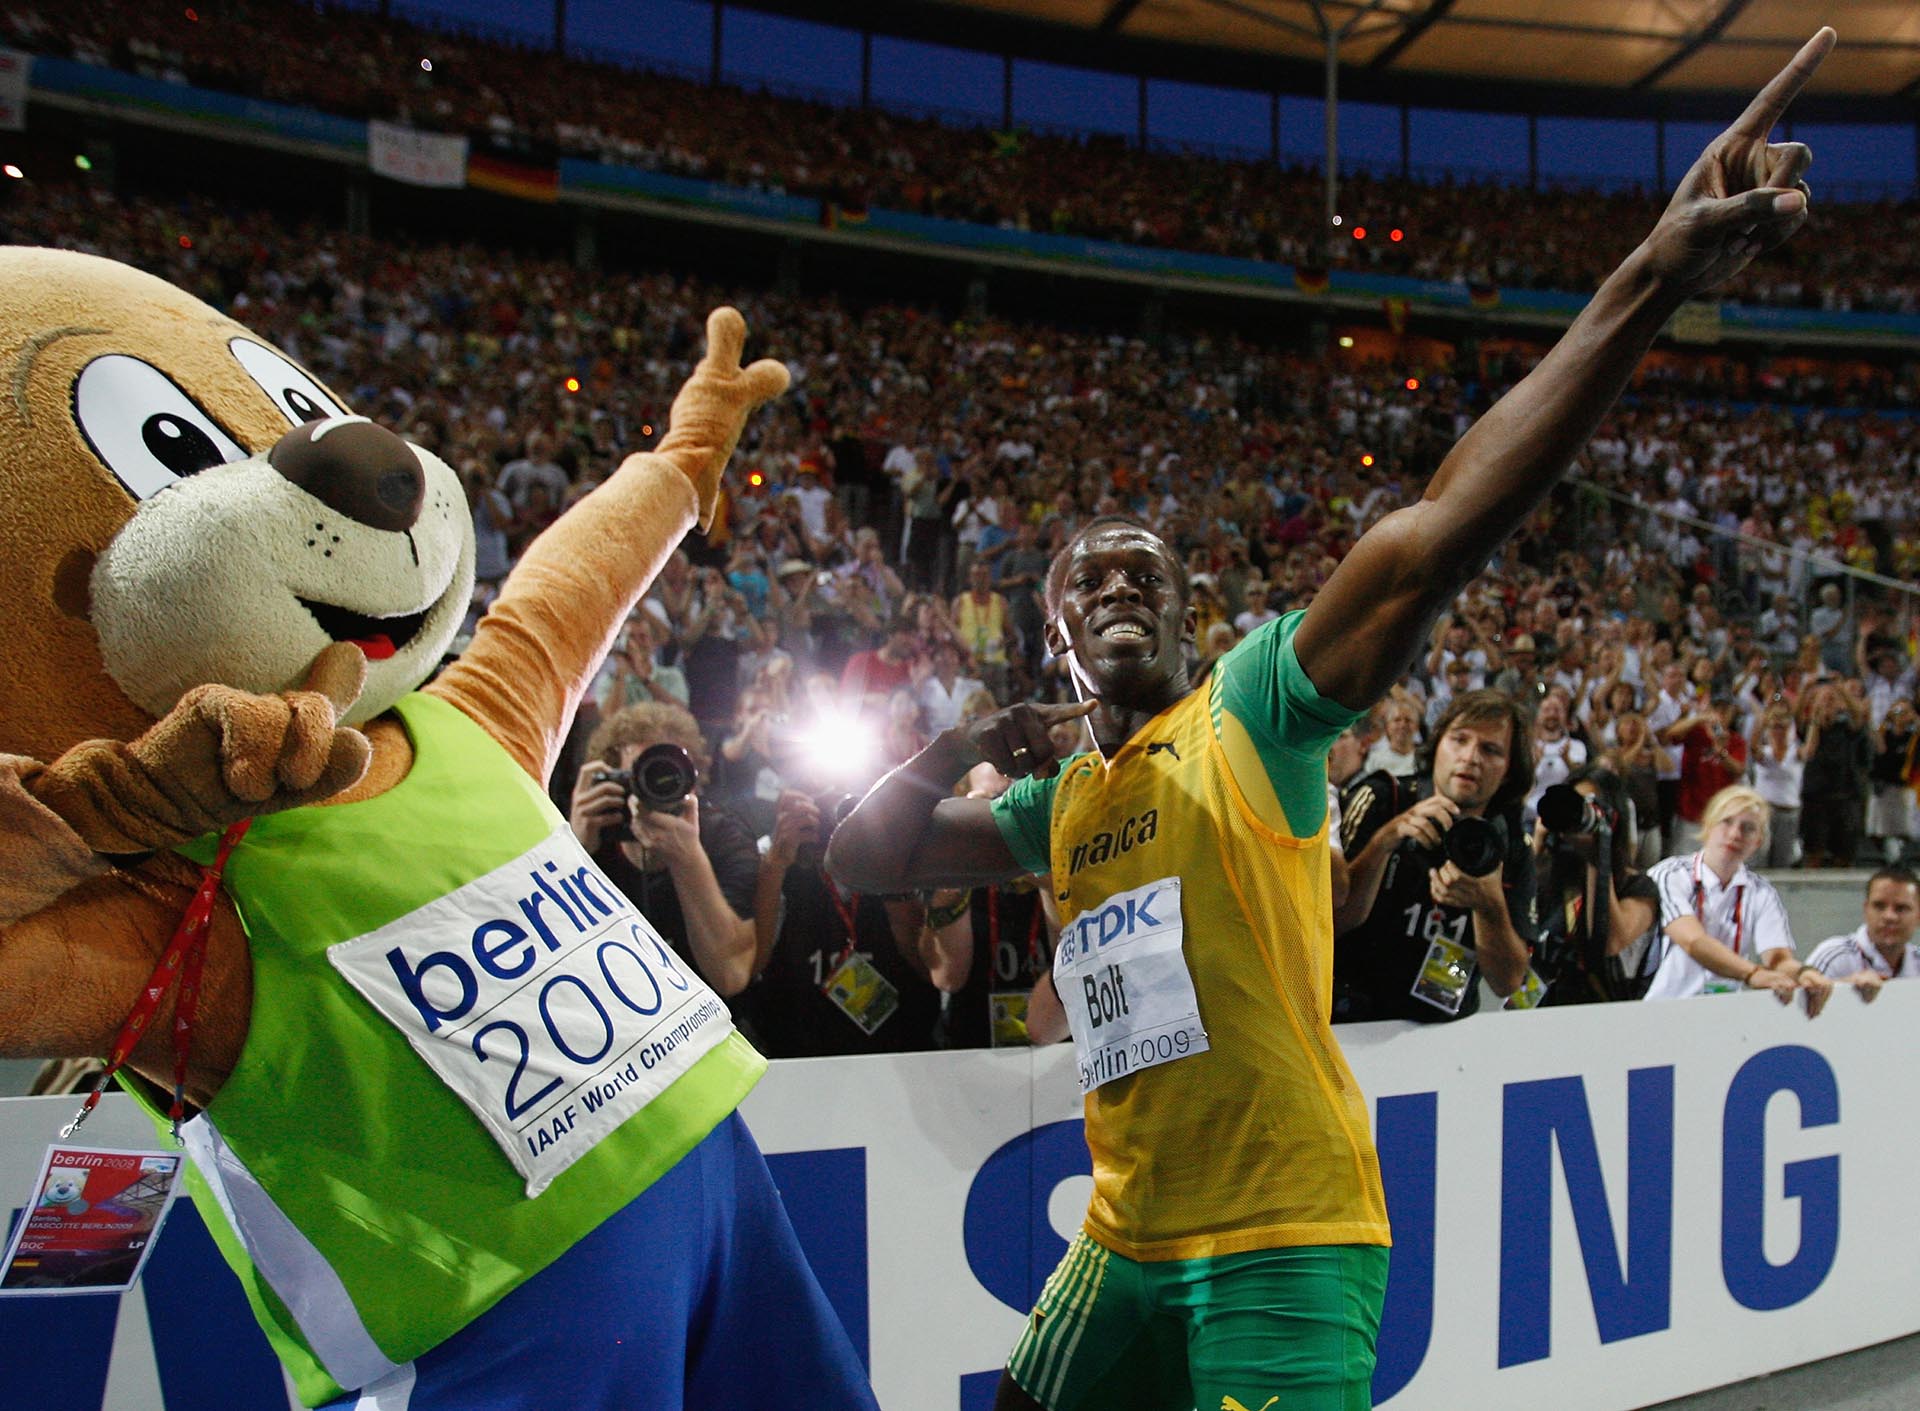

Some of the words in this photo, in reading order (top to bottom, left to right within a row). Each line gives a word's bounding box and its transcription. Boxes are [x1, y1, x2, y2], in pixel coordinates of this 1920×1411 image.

[385, 860, 625, 1034] berlin
[1077, 890, 1162, 954] TDK
[1083, 964, 1129, 1029] Bolt
[527, 1105, 577, 1157] IAAF
[581, 1063, 640, 1114] World
[640, 998, 721, 1070] Championships
[53, 1153, 103, 1167] berlin
[104, 1159, 136, 1169] 2009
